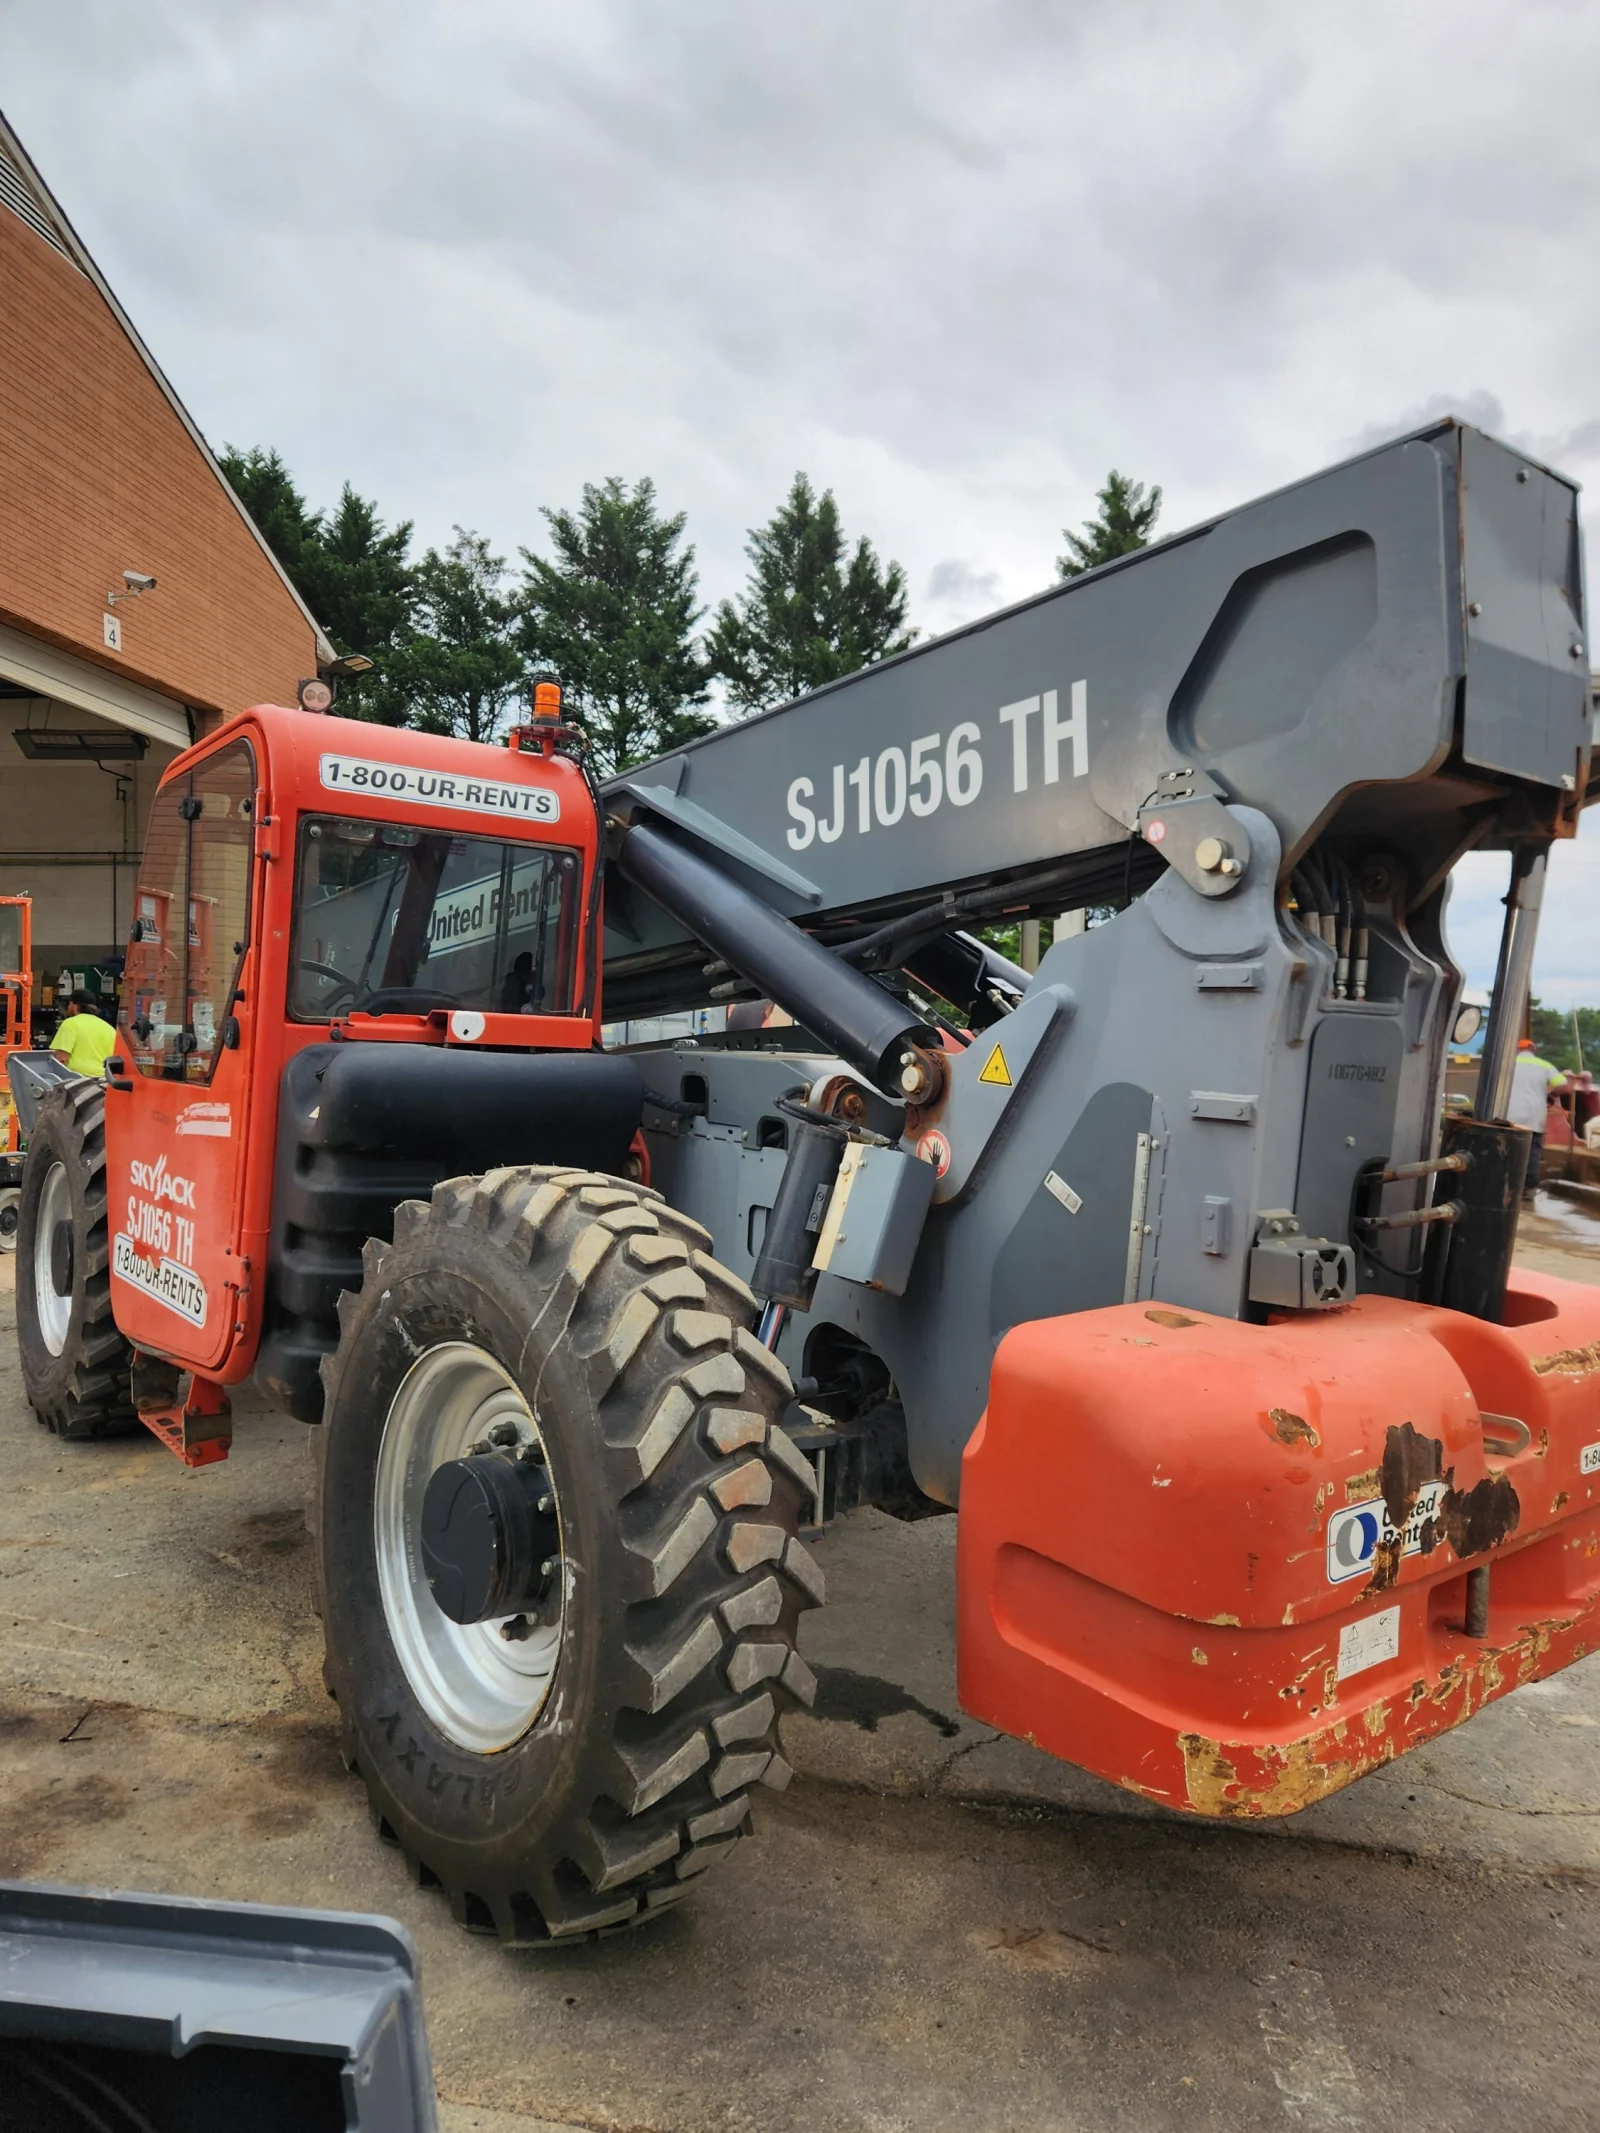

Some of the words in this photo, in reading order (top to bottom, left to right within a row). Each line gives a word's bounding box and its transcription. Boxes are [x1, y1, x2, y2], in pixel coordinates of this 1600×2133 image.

[109, 629, 116, 645] 4
[327, 762, 551, 814] 1-800-UR-RENTS
[787, 722, 984, 851] SJ1056
[999, 679, 1089, 793] TH
[426, 894, 485, 943] United
[489, 871, 562, 925] Rentl
[130, 1153, 195, 1209] SKYJACK
[127, 1196, 171, 1254] SJ1056
[176, 1216, 195, 1267] TH
[1383, 1490, 1437, 1528] Ued
